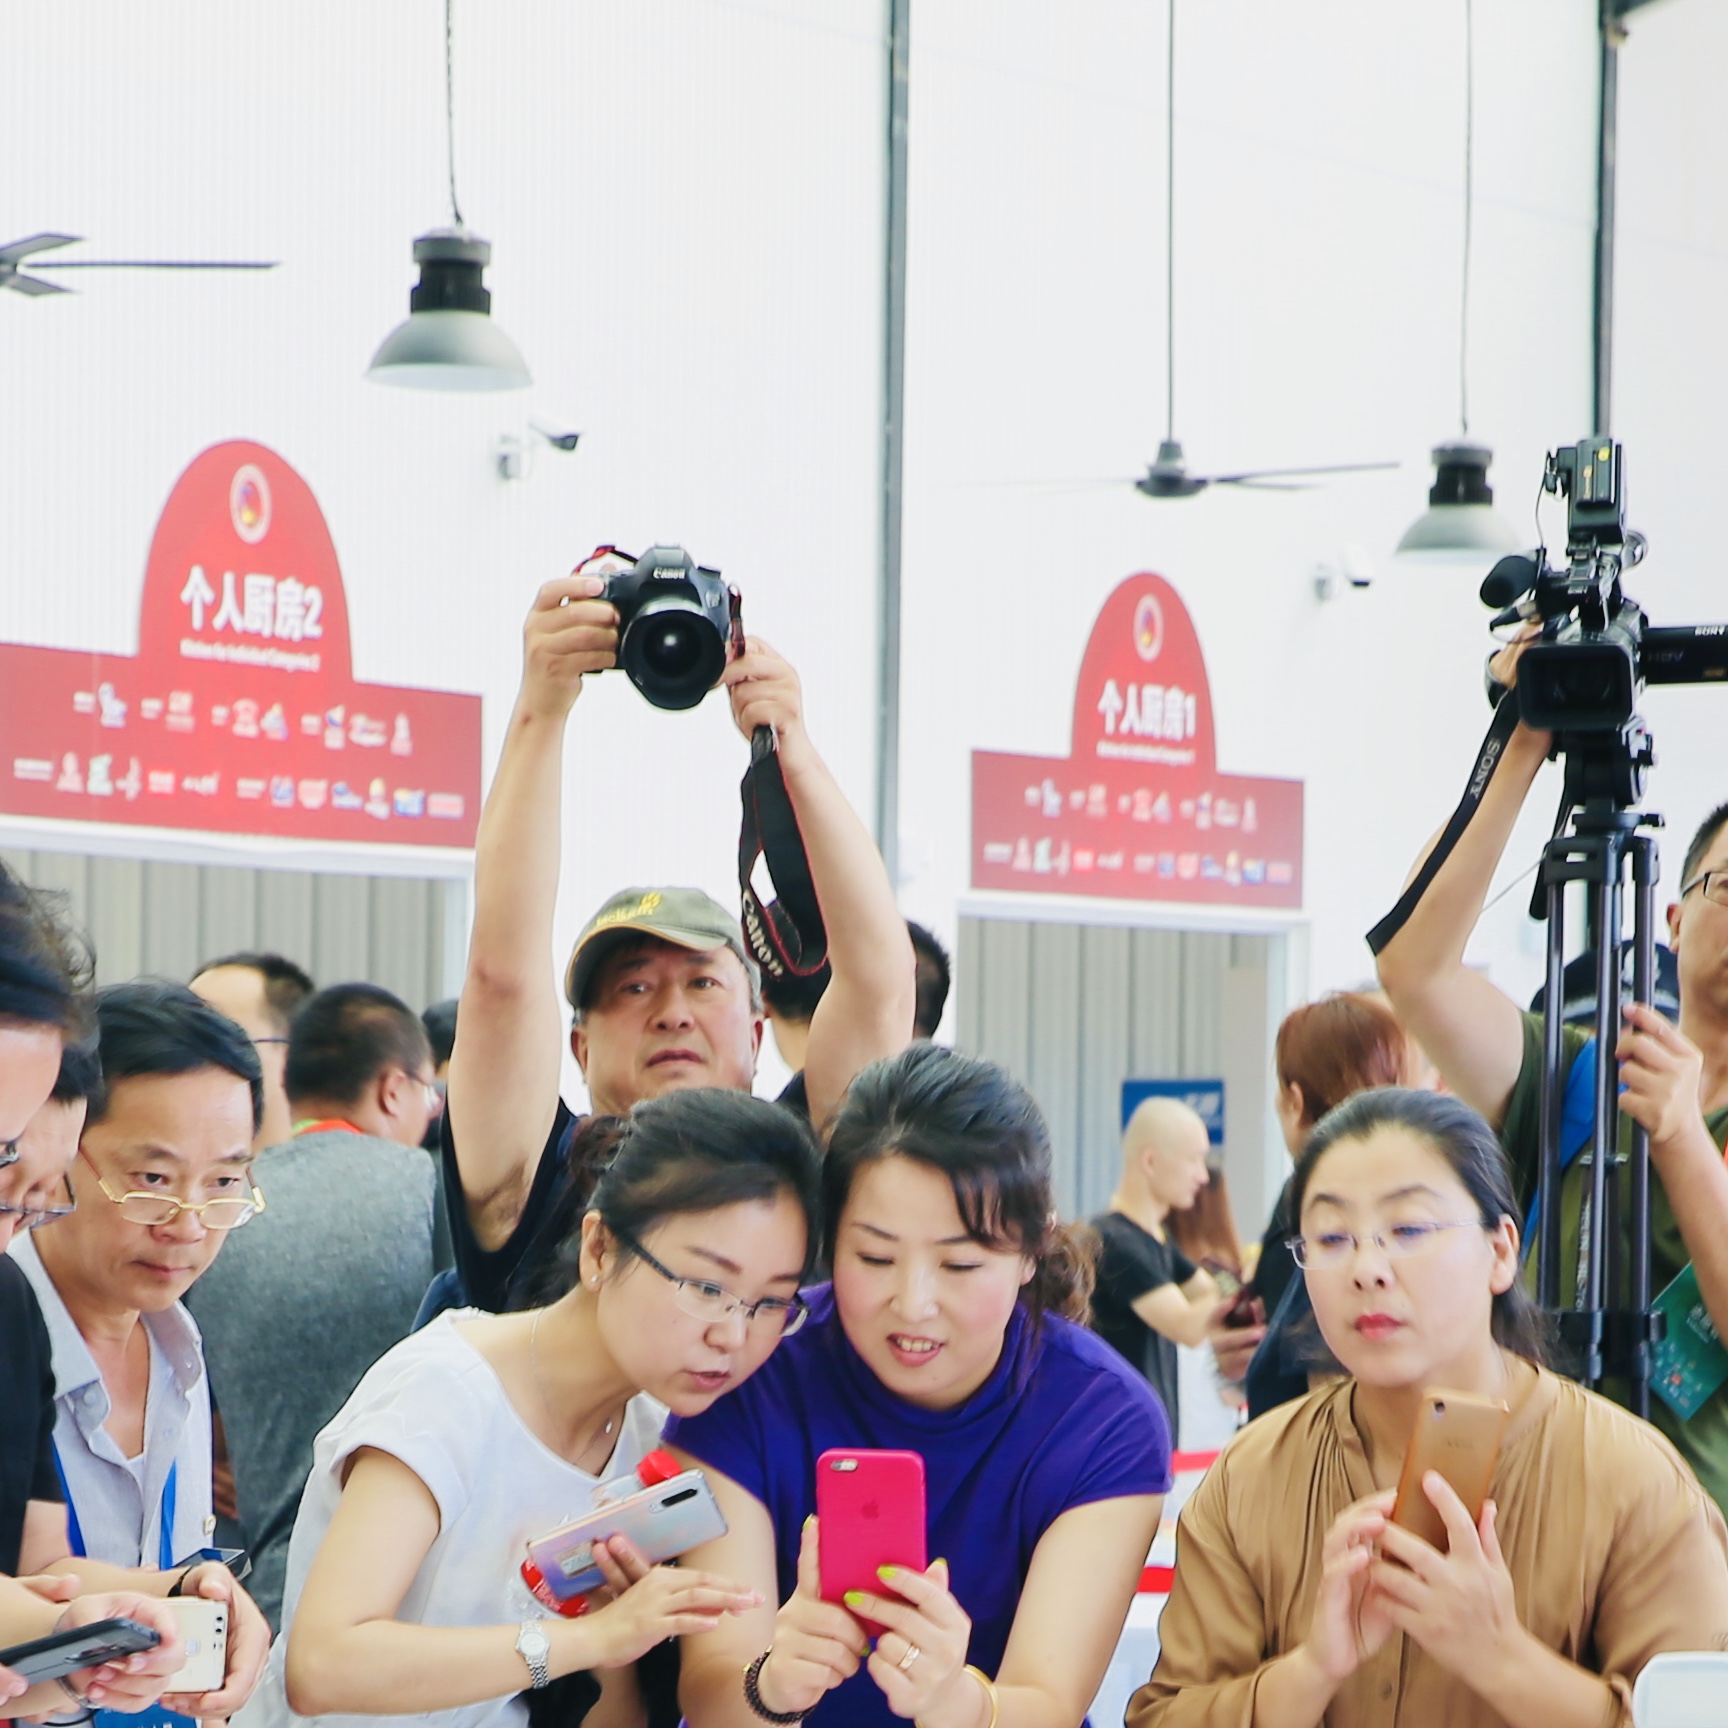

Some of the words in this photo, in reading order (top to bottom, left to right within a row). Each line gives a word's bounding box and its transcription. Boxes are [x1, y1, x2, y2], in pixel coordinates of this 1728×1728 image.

[180, 564, 323, 642] 个人厨房2
[653, 567, 686, 580] Canon
[1470, 739, 1501, 799] SONY
[743, 889, 784, 977] Canon
